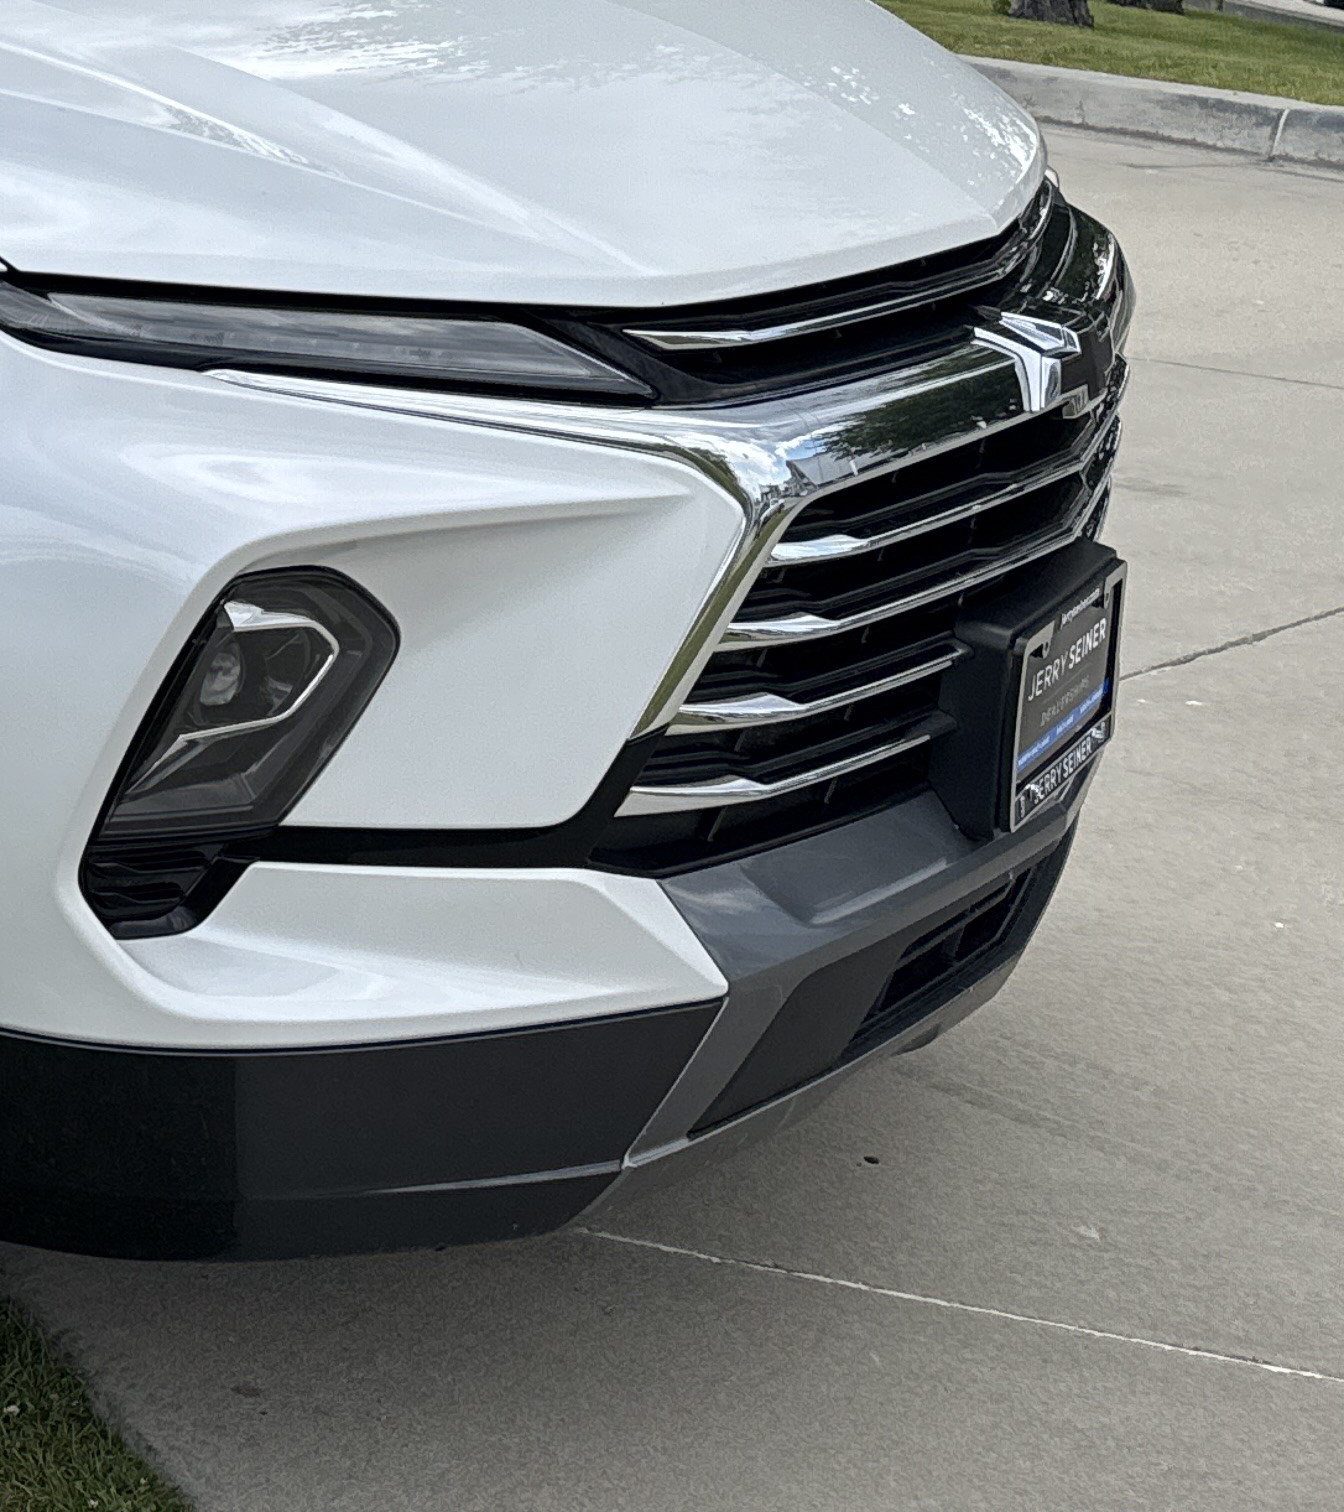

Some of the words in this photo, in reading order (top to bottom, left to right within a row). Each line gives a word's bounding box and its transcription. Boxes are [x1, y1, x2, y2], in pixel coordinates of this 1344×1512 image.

[1028, 651, 1068, 702] JERRY
[1067, 617, 1108, 670] SEINER
[1033, 760, 1064, 805] JERRY
[1062, 737, 1093, 778] SEINER
